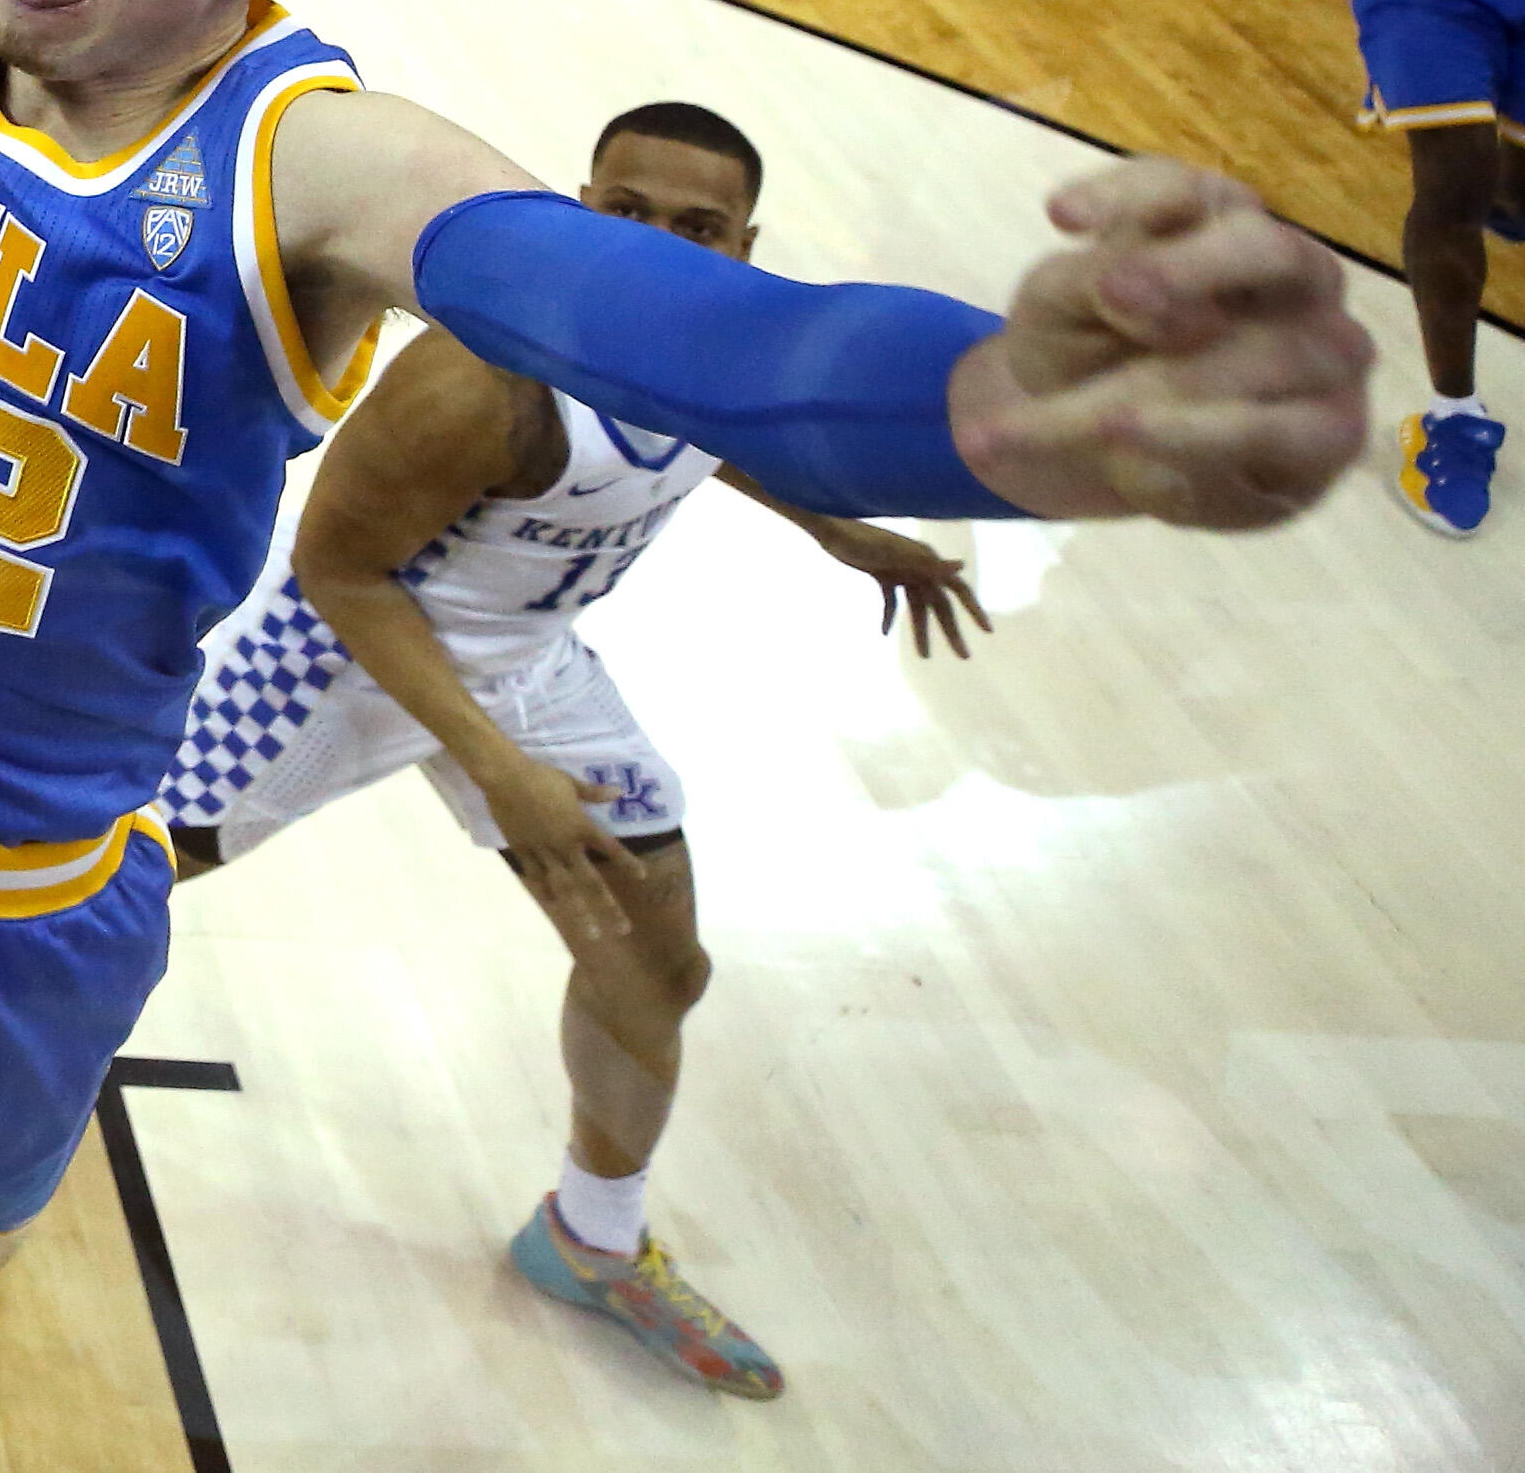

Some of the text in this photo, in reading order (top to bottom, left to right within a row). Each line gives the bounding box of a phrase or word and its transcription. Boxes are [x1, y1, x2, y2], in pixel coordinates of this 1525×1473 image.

[148, 171, 204, 199] JRW
[146, 207, 191, 247] PAC
[152, 233, 176, 257] 12
